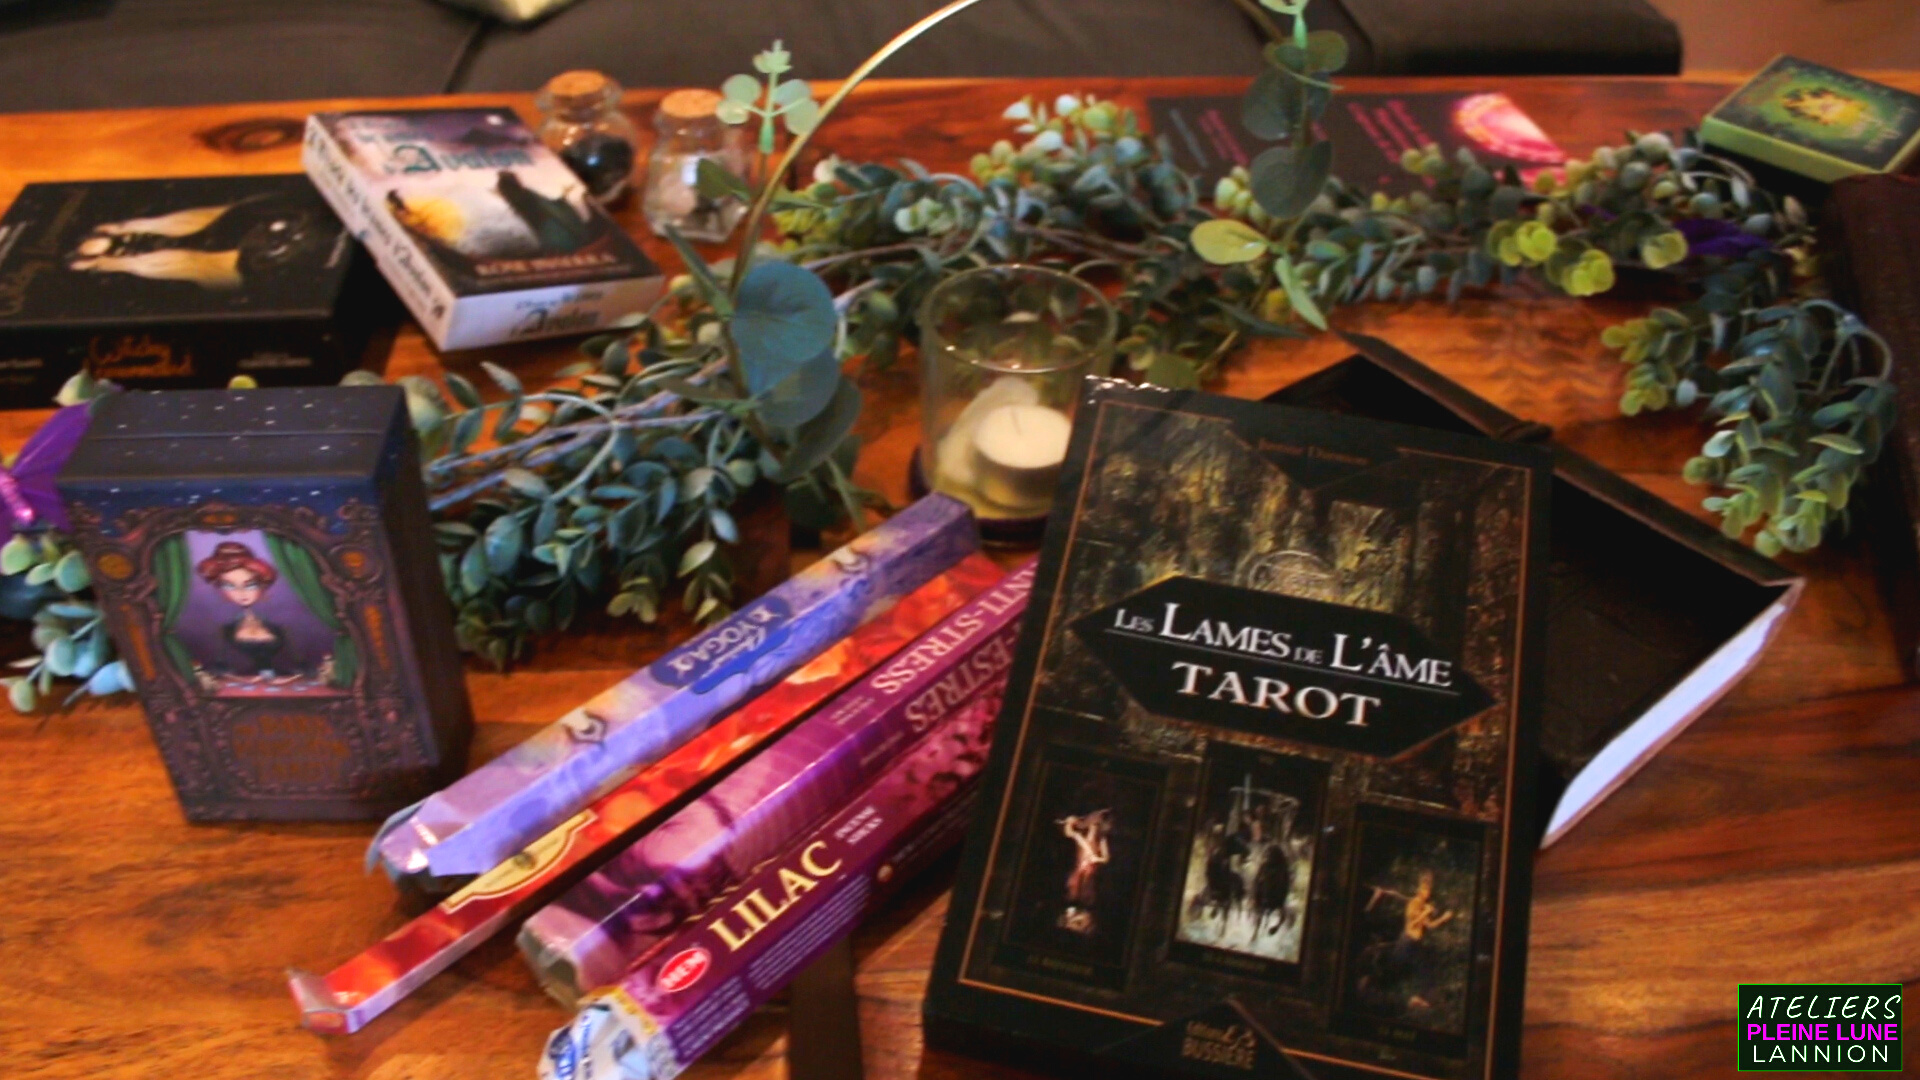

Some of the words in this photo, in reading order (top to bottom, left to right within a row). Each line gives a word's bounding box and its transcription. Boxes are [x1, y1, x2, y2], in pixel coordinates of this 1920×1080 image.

[687, 618, 762, 662] YOGA
[1113, 608, 1154, 633] LES
[1159, 602, 1291, 660] LAMES
[1293, 646, 1323, 665] DE
[1330, 633, 1453, 688] L'ÂME
[1171, 661, 1382, 727] TAROT
[707, 840, 842, 951] LILAC
